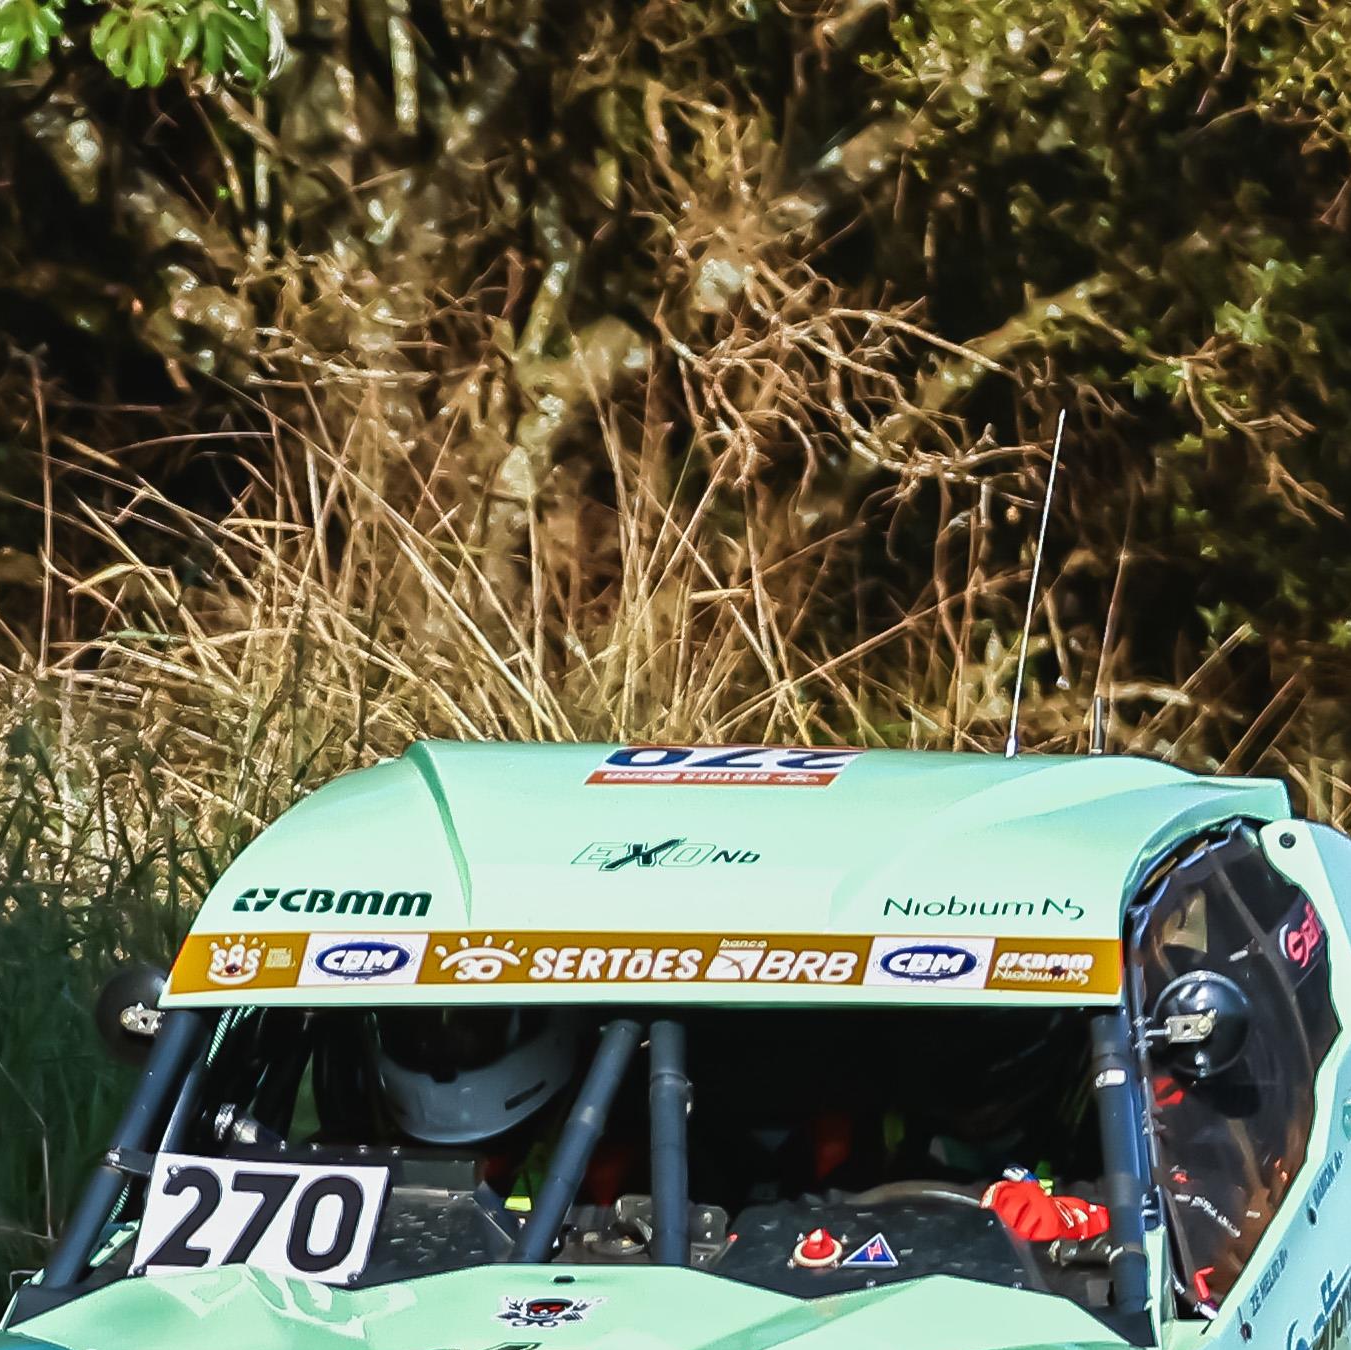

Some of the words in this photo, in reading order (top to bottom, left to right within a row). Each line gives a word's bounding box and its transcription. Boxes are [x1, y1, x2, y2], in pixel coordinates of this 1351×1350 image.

[279, 888, 432, 917] CBMM
[883, 895, 1034, 917] Niobium
[719, 938, 768, 949] banco
[323, 949, 400, 970] CBM
[454, 956, 502, 981] 30
[756, 949, 859, 983] BRB
[888, 952, 966, 974] CBM
[146, 1165, 365, 1274] 270
